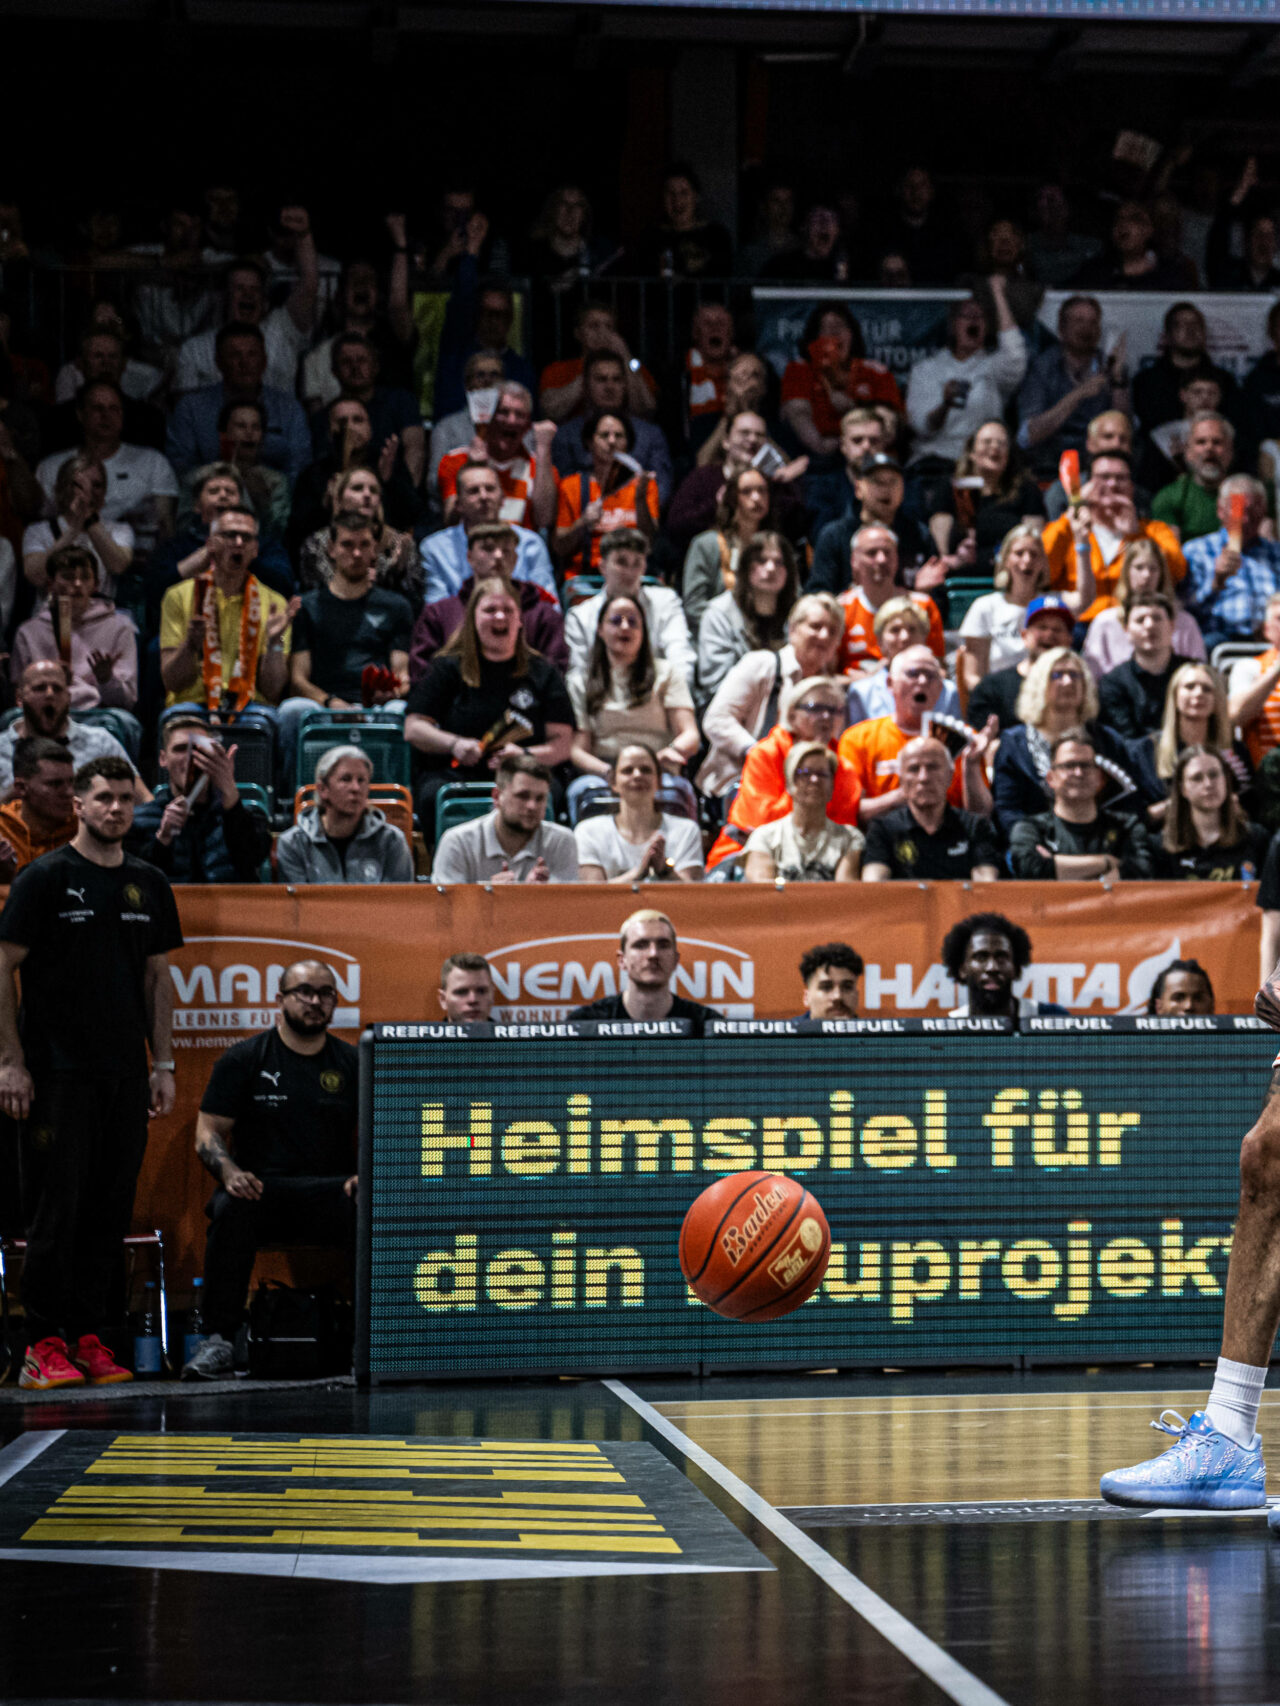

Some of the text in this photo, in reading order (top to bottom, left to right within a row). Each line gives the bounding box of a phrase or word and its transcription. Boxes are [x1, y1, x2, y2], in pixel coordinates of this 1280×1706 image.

[489, 961, 754, 1000] NEMNN
[421, 1088, 1141, 1176] Heimspiel für
[721, 1184, 789, 1267] Baden
[413, 1232, 645, 1311] dein
[688, 1219, 1238, 1324] uprojek
